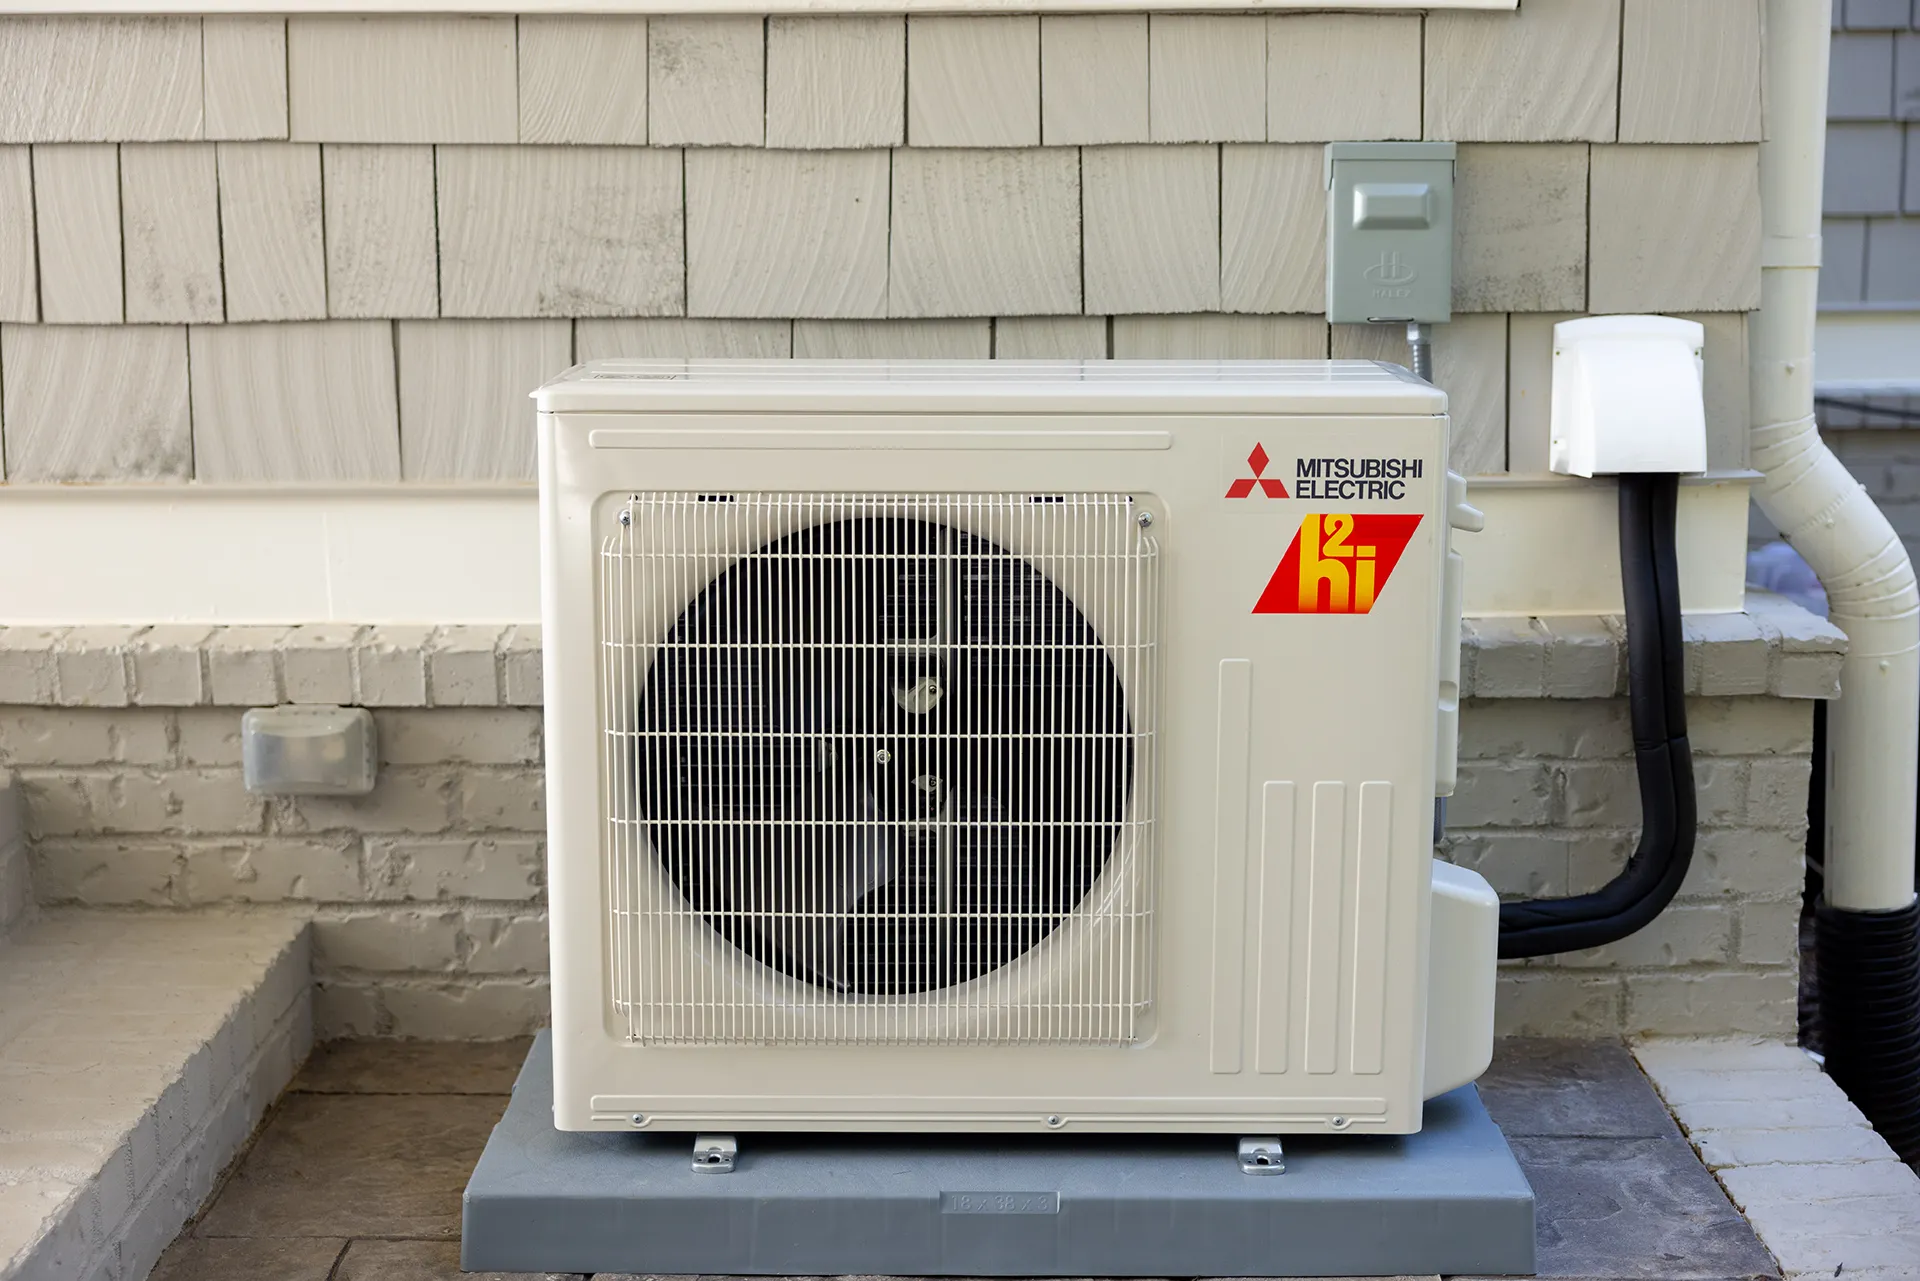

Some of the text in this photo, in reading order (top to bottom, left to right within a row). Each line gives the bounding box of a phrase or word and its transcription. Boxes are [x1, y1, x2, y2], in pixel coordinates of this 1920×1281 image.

[1296, 458, 1423, 479] MITSUBISHI
[1295, 480, 1406, 500] ELECTRIC
[952, 1195, 973, 1211] 18
[994, 1195, 1016, 1211] 38
[1037, 1195, 1050, 1211] 3
